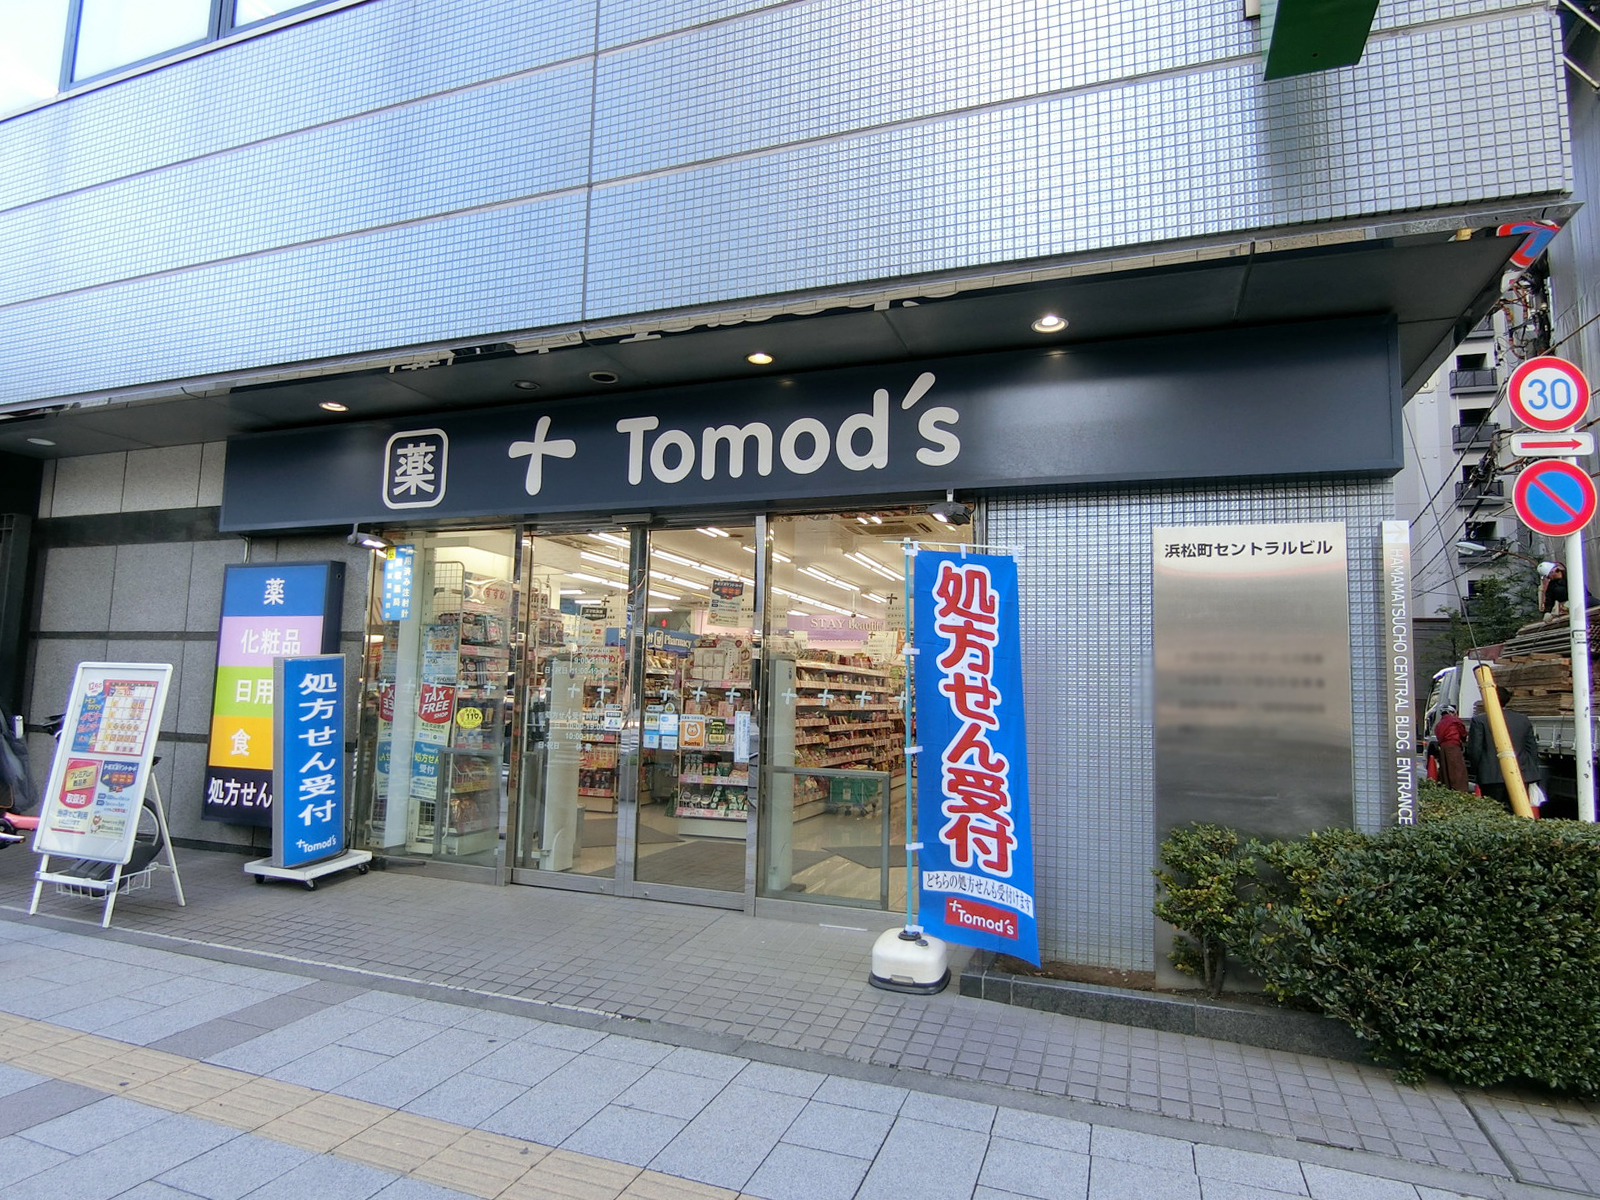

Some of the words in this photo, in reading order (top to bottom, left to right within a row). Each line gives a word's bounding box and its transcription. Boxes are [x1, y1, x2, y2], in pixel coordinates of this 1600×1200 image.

[1528, 379, 1571, 410] 30
[616, 372, 960, 486] Tomod's
[393, 443, 436, 495] 薬
[1165, 540, 1333, 558] 浜松町セントラルビル
[263, 578, 285, 605] 薬
[1390, 548, 1407, 653] HAMAMATSUCHO
[810, 618, 846, 629] STAY
[241, 628, 301, 655] 化粧品
[664, 634, 692, 648] Pharmacy
[424, 689, 447, 704] TAX
[1393, 655, 1409, 712] CENTRAL
[421, 699, 450, 716] FREE
[433, 711, 449, 720] SHOP
[936, 565, 1014, 873] 処方せん受付
[231, 728, 251, 756] 食
[1395, 715, 1410, 753] BLDG.
[298, 673, 337, 827] 処方せん受付
[208, 776, 273, 808] 処方せん
[1396, 757, 1413, 826] ENTRANCE
[302, 834, 337, 852] Tomod's
[927, 873, 1031, 913] どちらの処方せんも受付けます
[958, 909, 1014, 935] Tomod's
